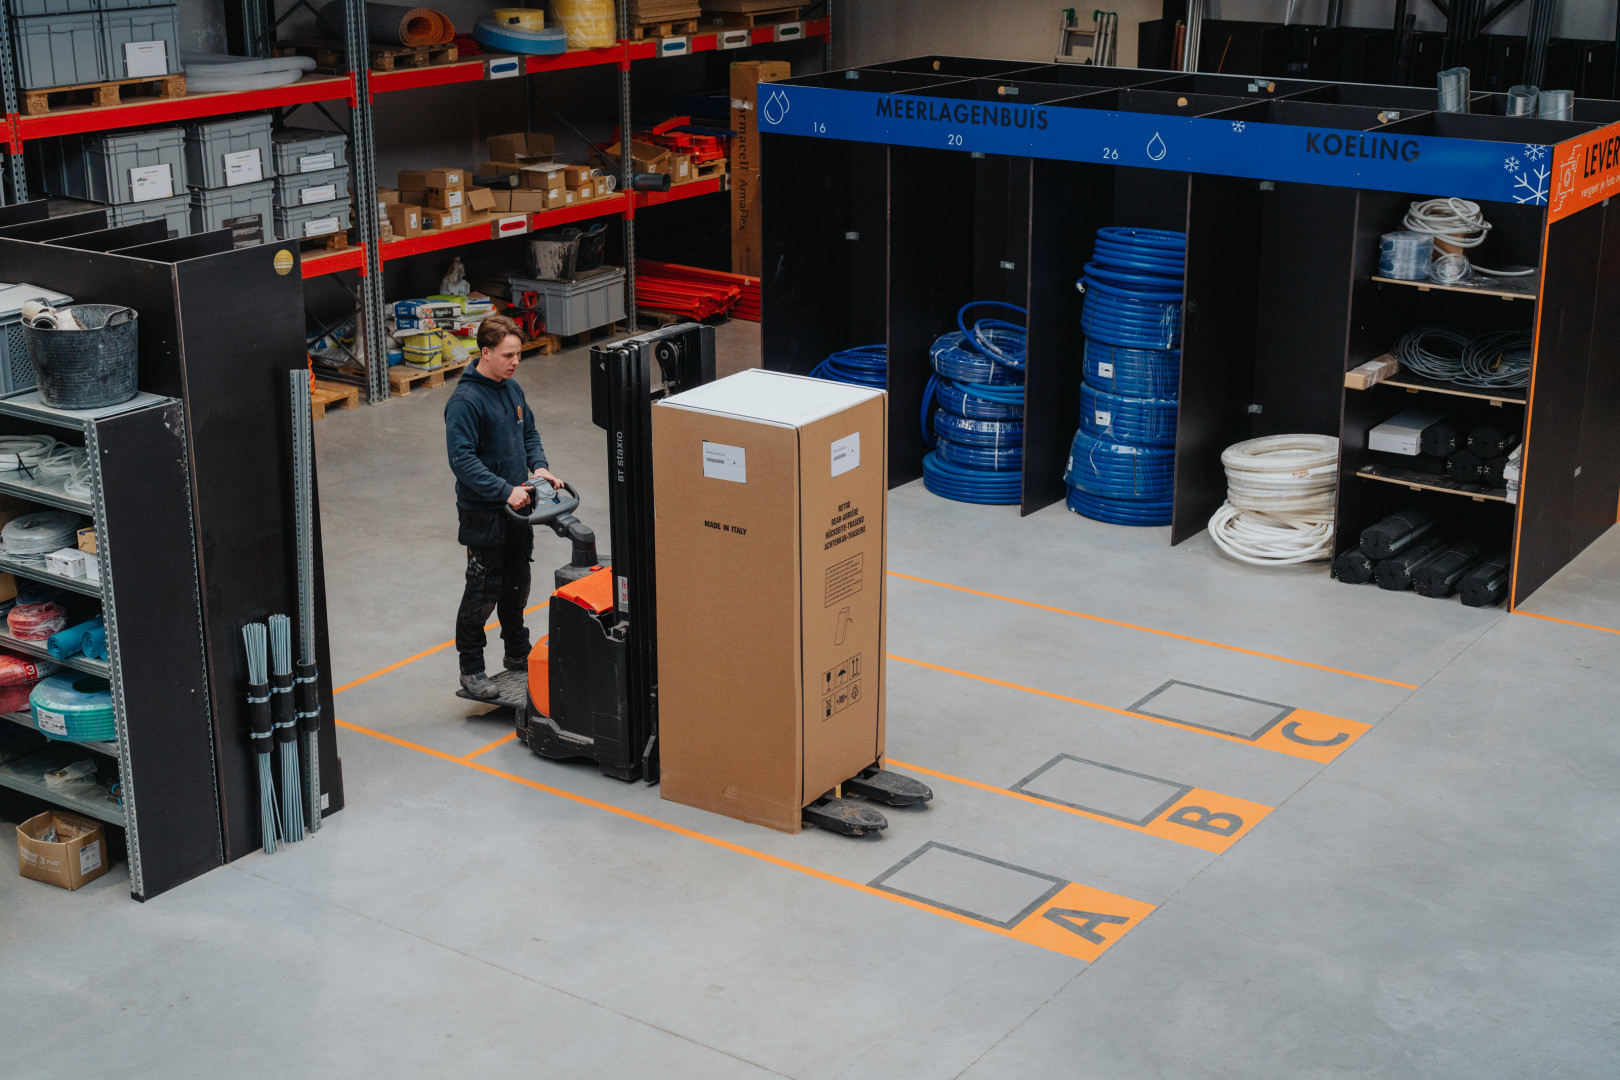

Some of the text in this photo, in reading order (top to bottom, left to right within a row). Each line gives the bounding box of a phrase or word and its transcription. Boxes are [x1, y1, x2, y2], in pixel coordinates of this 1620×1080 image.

[876, 97, 1048, 130] MEERLAGENBUIS
[813, 122, 826, 133] 16
[948, 134, 963, 146] 20
[1103, 147, 1119, 160] 26
[1306, 132, 1420, 162] KOELING
[738, 178, 750, 232] ArmaFlex
[616, 431, 625, 482] BT staxio
[838, 500, 851, 512] RETRO
[704, 519, 747, 536] MADE IN ITALY
[26, 664, 35, 675] 3
[1281, 720, 1350, 747] C
[1166, 805, 1244, 837] B
[1042, 907, 1131, 946] A
